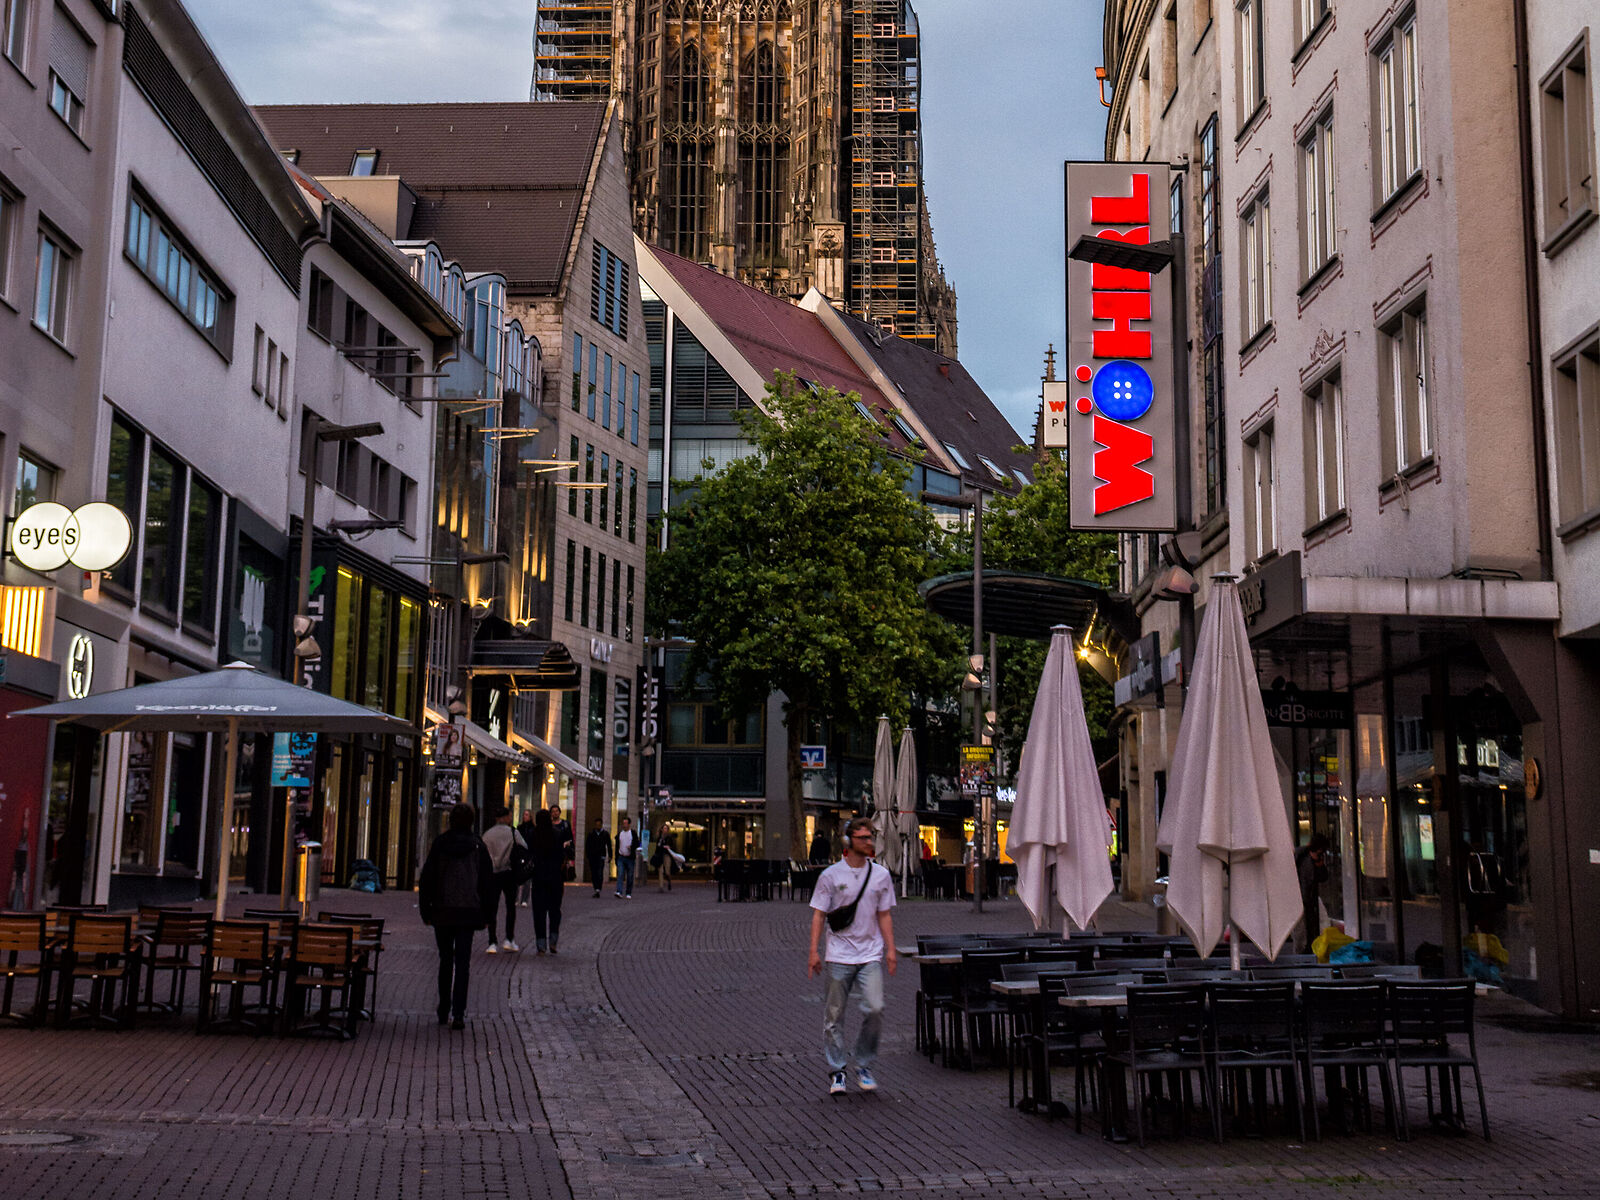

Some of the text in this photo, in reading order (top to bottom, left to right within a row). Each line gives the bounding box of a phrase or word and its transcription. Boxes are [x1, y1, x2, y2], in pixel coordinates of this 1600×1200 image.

[1048, 401, 1067, 413] W
[19, 527, 76, 550] eyes
[303, 594, 325, 690] Tlia
[588, 755, 603, 771] ONLY
